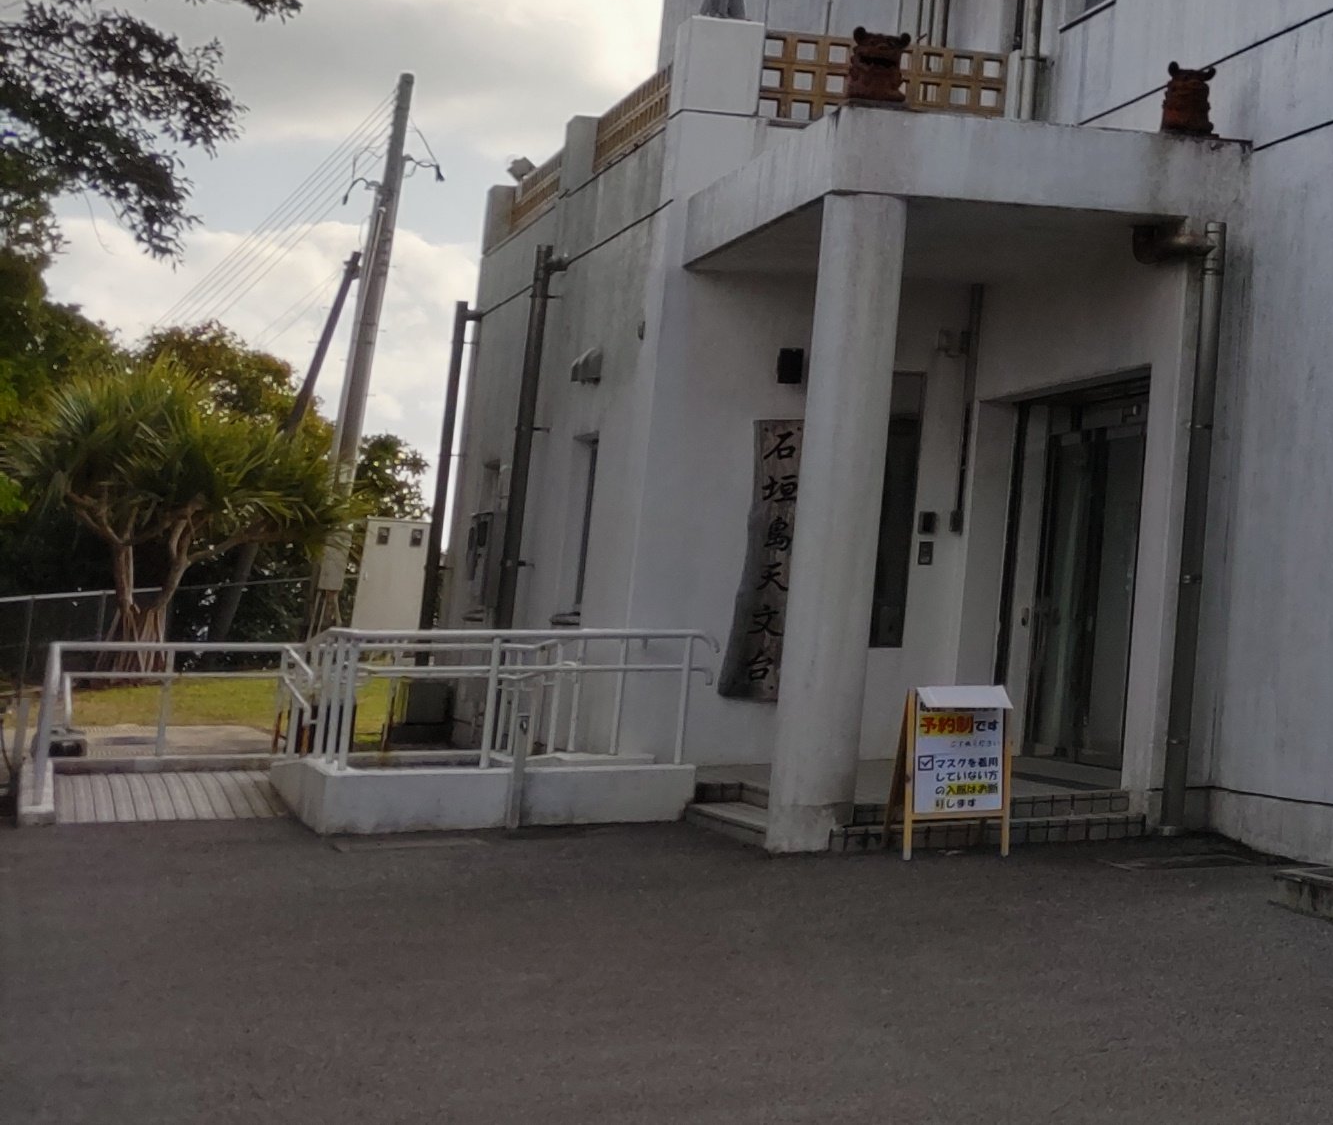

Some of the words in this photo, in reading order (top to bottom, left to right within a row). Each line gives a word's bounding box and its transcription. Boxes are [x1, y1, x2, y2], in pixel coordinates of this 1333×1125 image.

[748, 431, 797, 681] 石垣島天文台
[935, 757, 998, 769] マスクを着用
[936, 770, 998, 782] していない方
